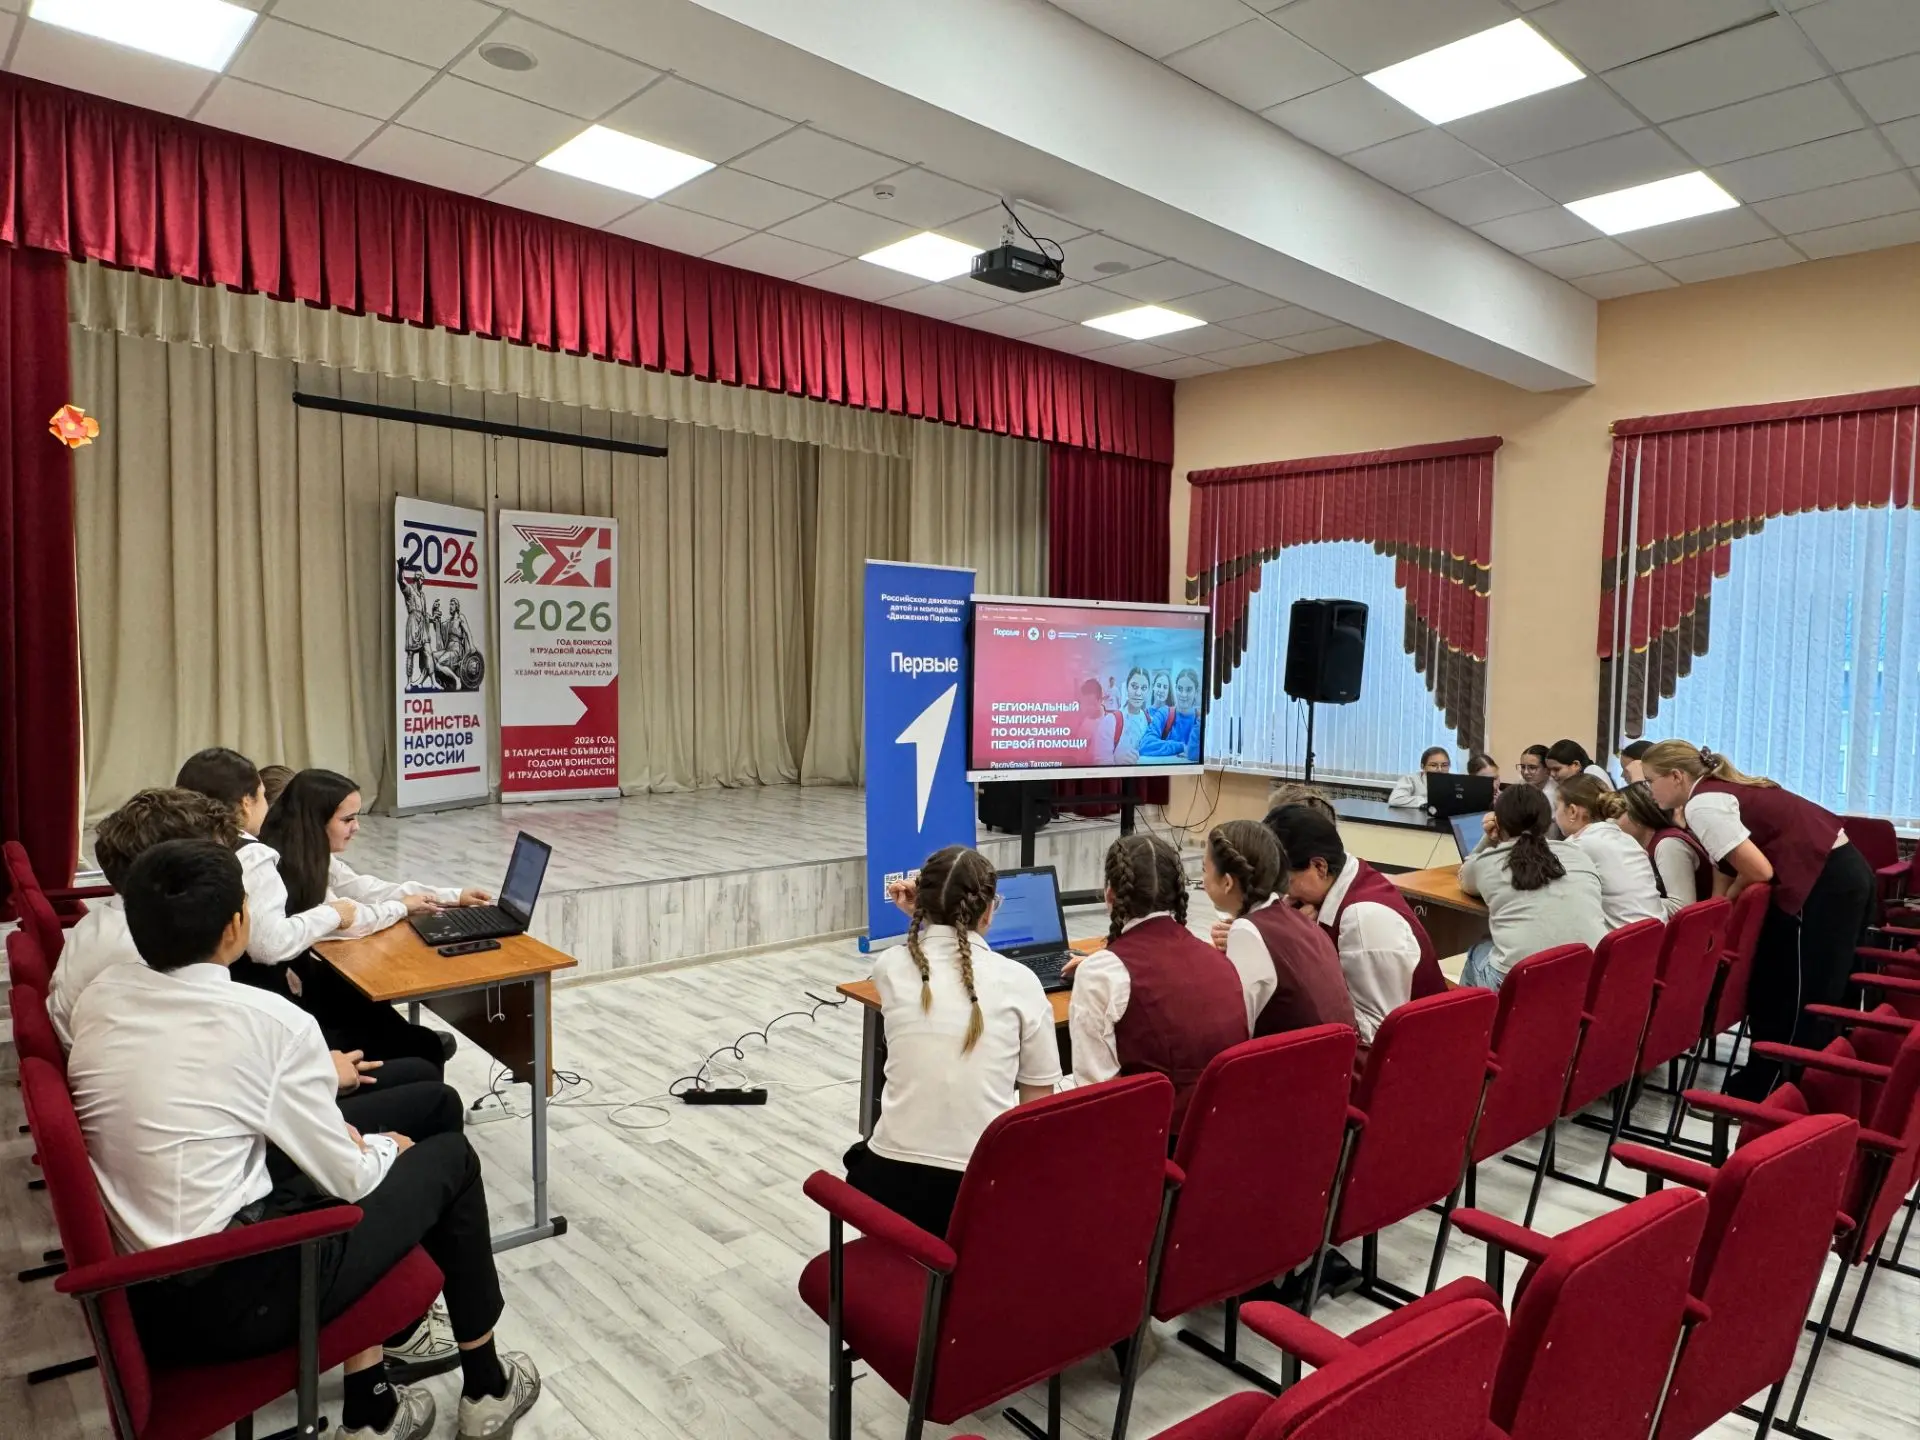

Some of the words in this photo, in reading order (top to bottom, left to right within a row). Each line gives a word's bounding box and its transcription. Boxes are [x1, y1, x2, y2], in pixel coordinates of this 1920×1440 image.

[403, 532, 478, 578] 2026
[881, 593, 927, 603] Российское
[927, 597, 965, 606] движение
[513, 598, 612, 632] 2026
[919, 605, 958, 614] молодёжи
[536, 647, 574, 655] ТРУДОВОЙ
[891, 652, 958, 679] Первые
[404, 698, 433, 715] ГОД
[991, 701, 1080, 712] РЕГИОНАЛЬНЫЙ
[404, 714, 480, 734] ЕДИНСТВА
[991, 714, 1058, 724] ЧЕМПИОНАТ
[991, 728, 1007, 737] ПО
[1009, 727, 1071, 736] ОКАЗАНИЮ
[404, 732, 474, 750] НАРОДОВ
[574, 736, 595, 744] 2026
[596, 736, 616, 744] ГОД
[991, 738, 1035, 750] ПЕРВОЙ
[1036, 738, 1088, 750] ПОМОЩИ
[504, 749, 510, 757] В
[512, 748, 568, 757] ТАТАРСТАНЕ
[570, 746, 615, 756] ОБЪЯВЛЕН
[404, 749, 464, 768] РОССИИ
[527, 759, 562, 768] ГОДОМ
[564, 756, 615, 766] ВОИНСКОЙ
[508, 771, 514, 780] И
[517, 768, 566, 779] ТРУДОВОЙ
[568, 768, 615, 778] ДОБЛЕСТИ
